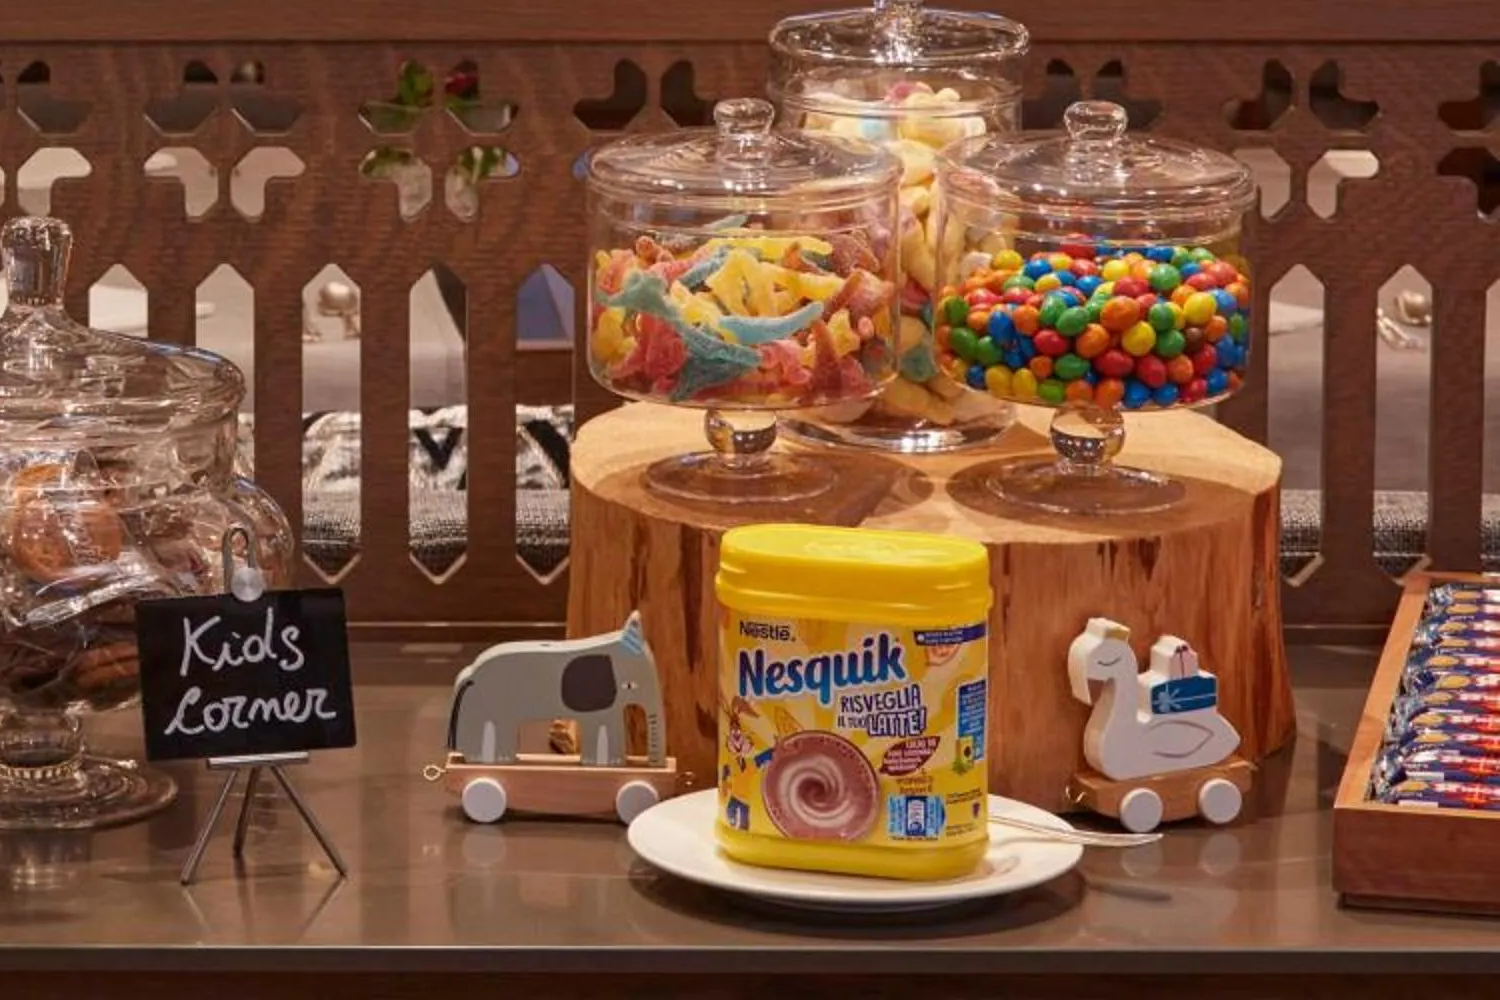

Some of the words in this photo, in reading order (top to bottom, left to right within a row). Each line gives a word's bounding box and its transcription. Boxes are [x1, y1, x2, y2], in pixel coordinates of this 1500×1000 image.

[179, 607, 306, 677] Kids
[739, 633, 906, 705] Nesquik
[164, 686, 337, 735] Corner
[840, 684, 922, 712] RISVEGLIA
[867, 707, 927, 737] LATTE!
